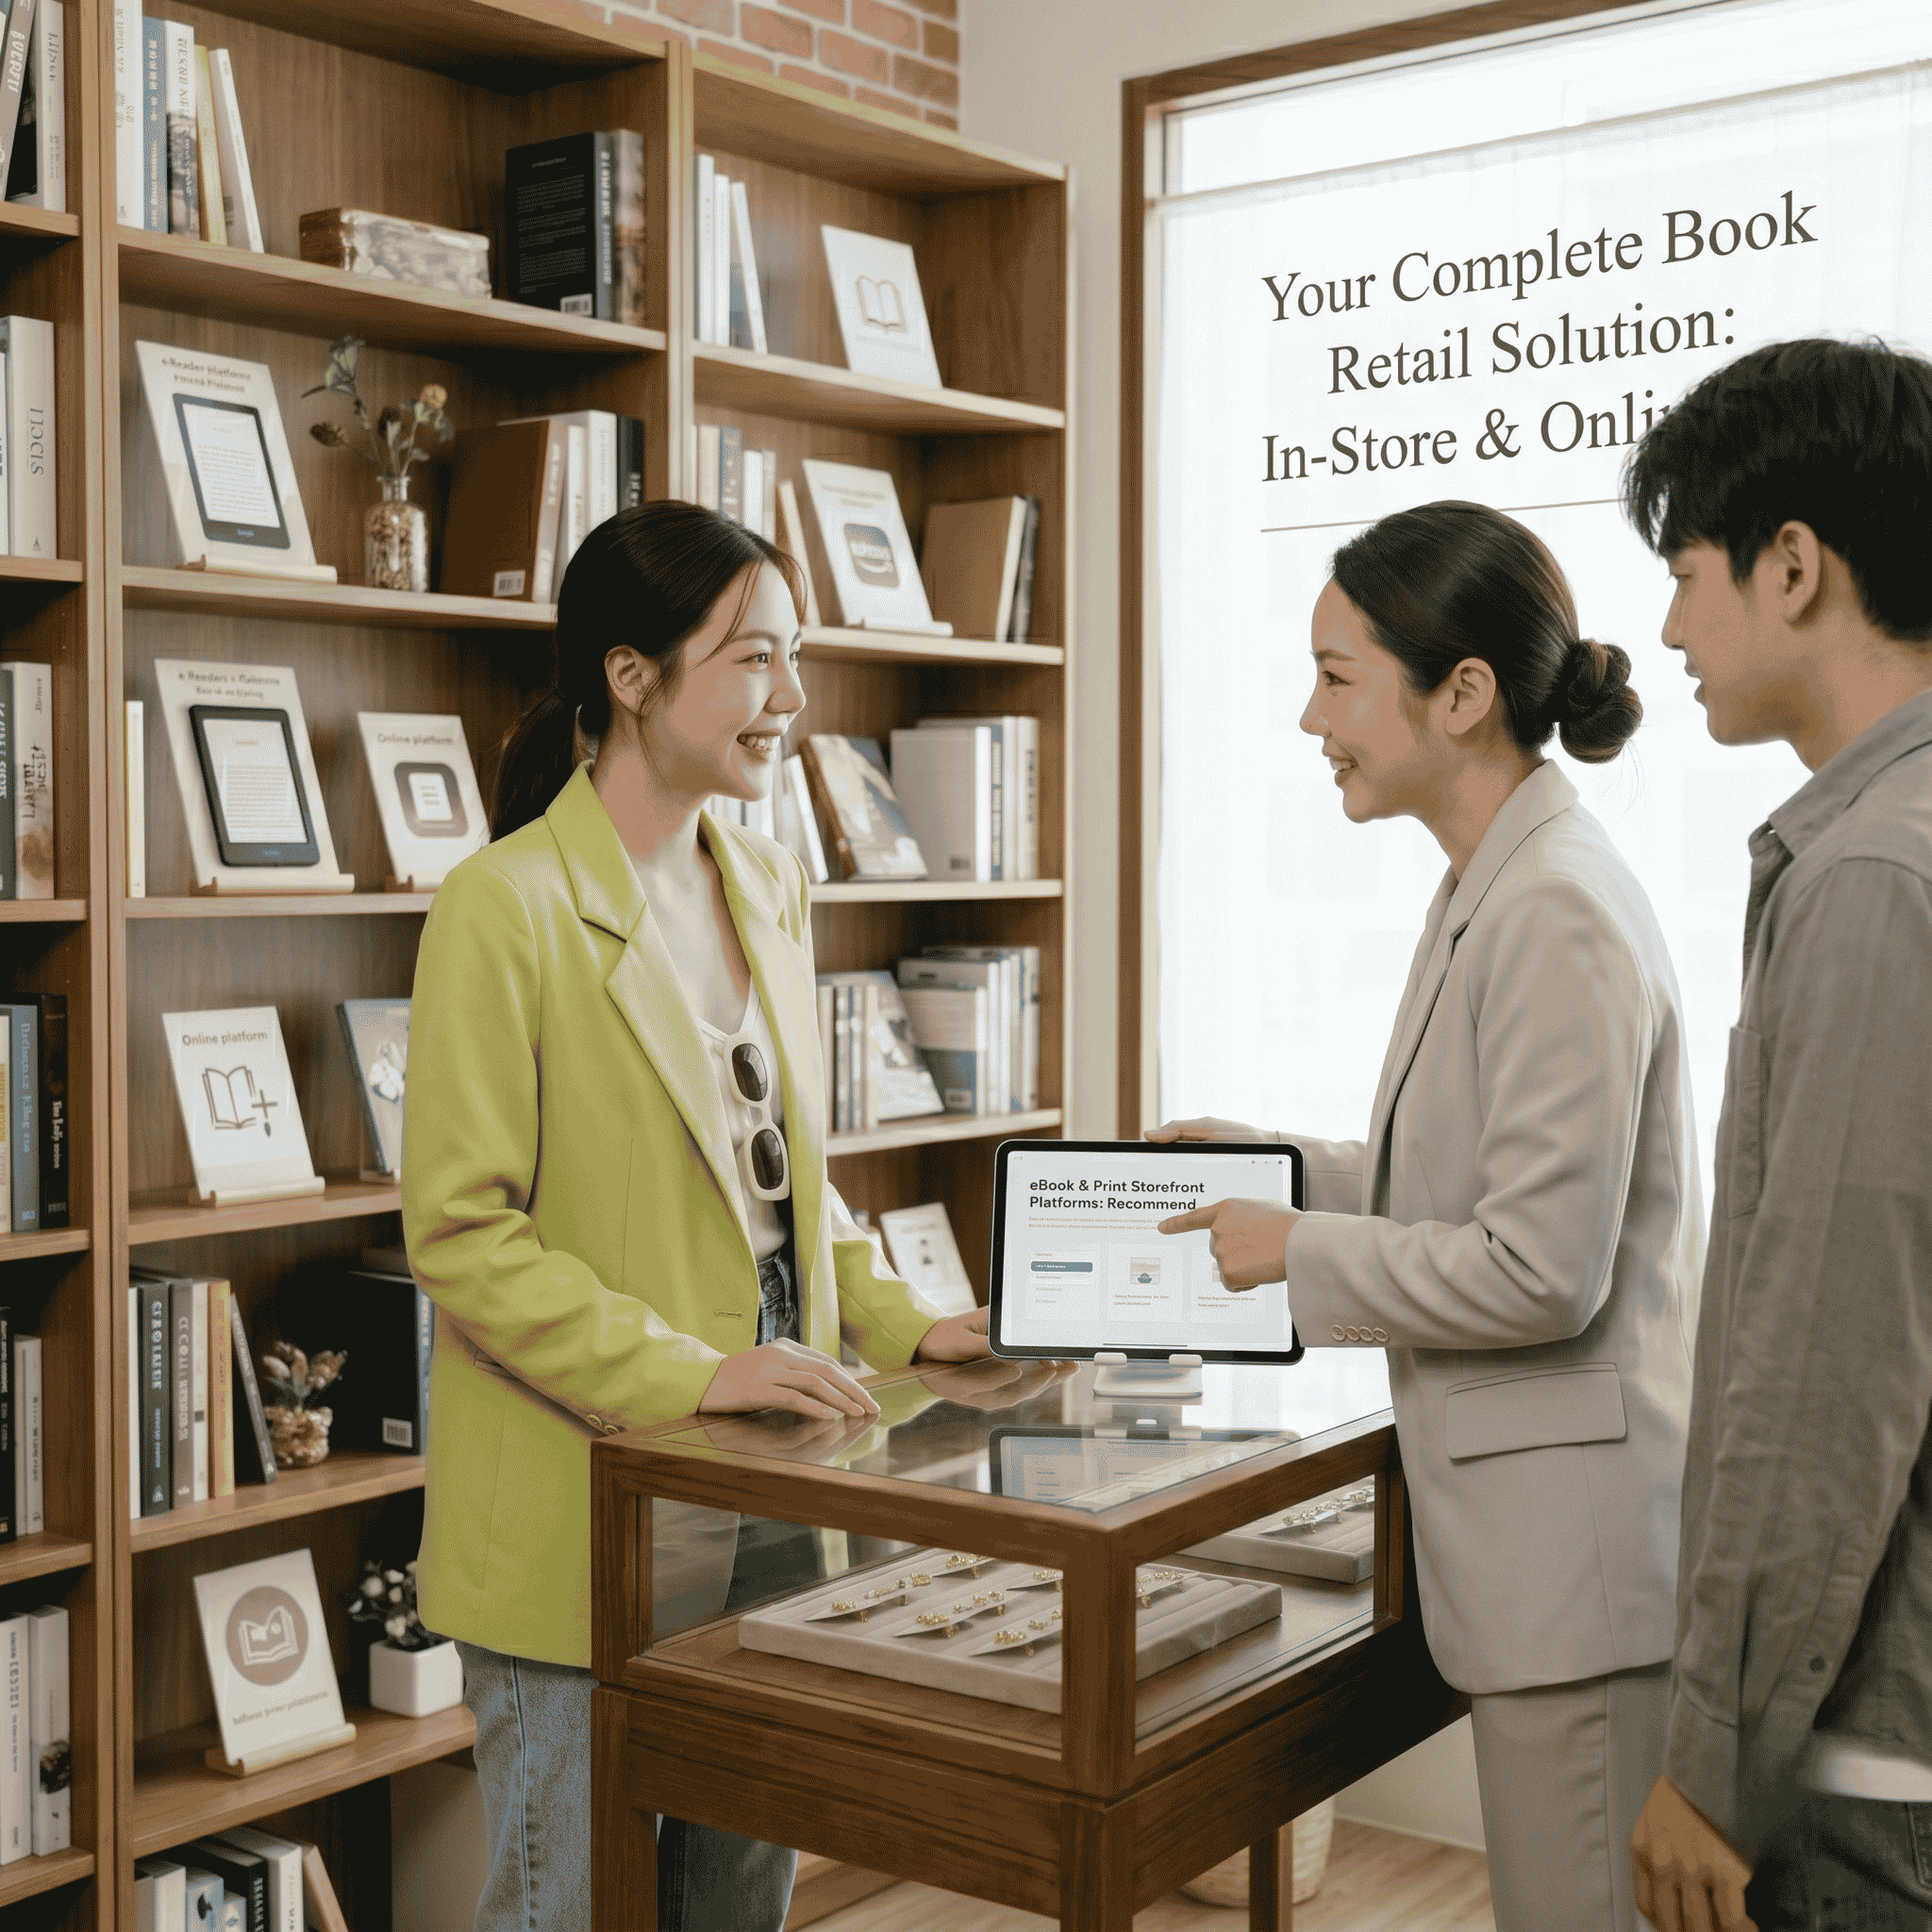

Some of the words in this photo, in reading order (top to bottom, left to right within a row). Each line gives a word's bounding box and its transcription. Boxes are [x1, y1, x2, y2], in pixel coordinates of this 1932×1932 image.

[1260, 272, 1376, 322] Your
[1392, 227, 1643, 301] Complete
[1661, 190, 1819, 264] Book
[1327, 326, 1473, 394] Retail
[1492, 302, 1734, 375] Solution:
[1261, 425, 1457, 482] In-Store
[1475, 408, 1522, 460] &
[1541, 390, 1671, 453] Onli
[182, 1034, 218, 1046] Online
[221, 1030, 268, 1045] platform
[1029, 1178, 1074, 1191] eBook
[1078, 1179, 1090, 1191] &
[1093, 1179, 1127, 1192] Print
[1131, 1180, 1205, 1193] Storefront
[1029, 1195, 1104, 1208] Platforms:
[1107, 1198, 1196, 1210] Recommend
